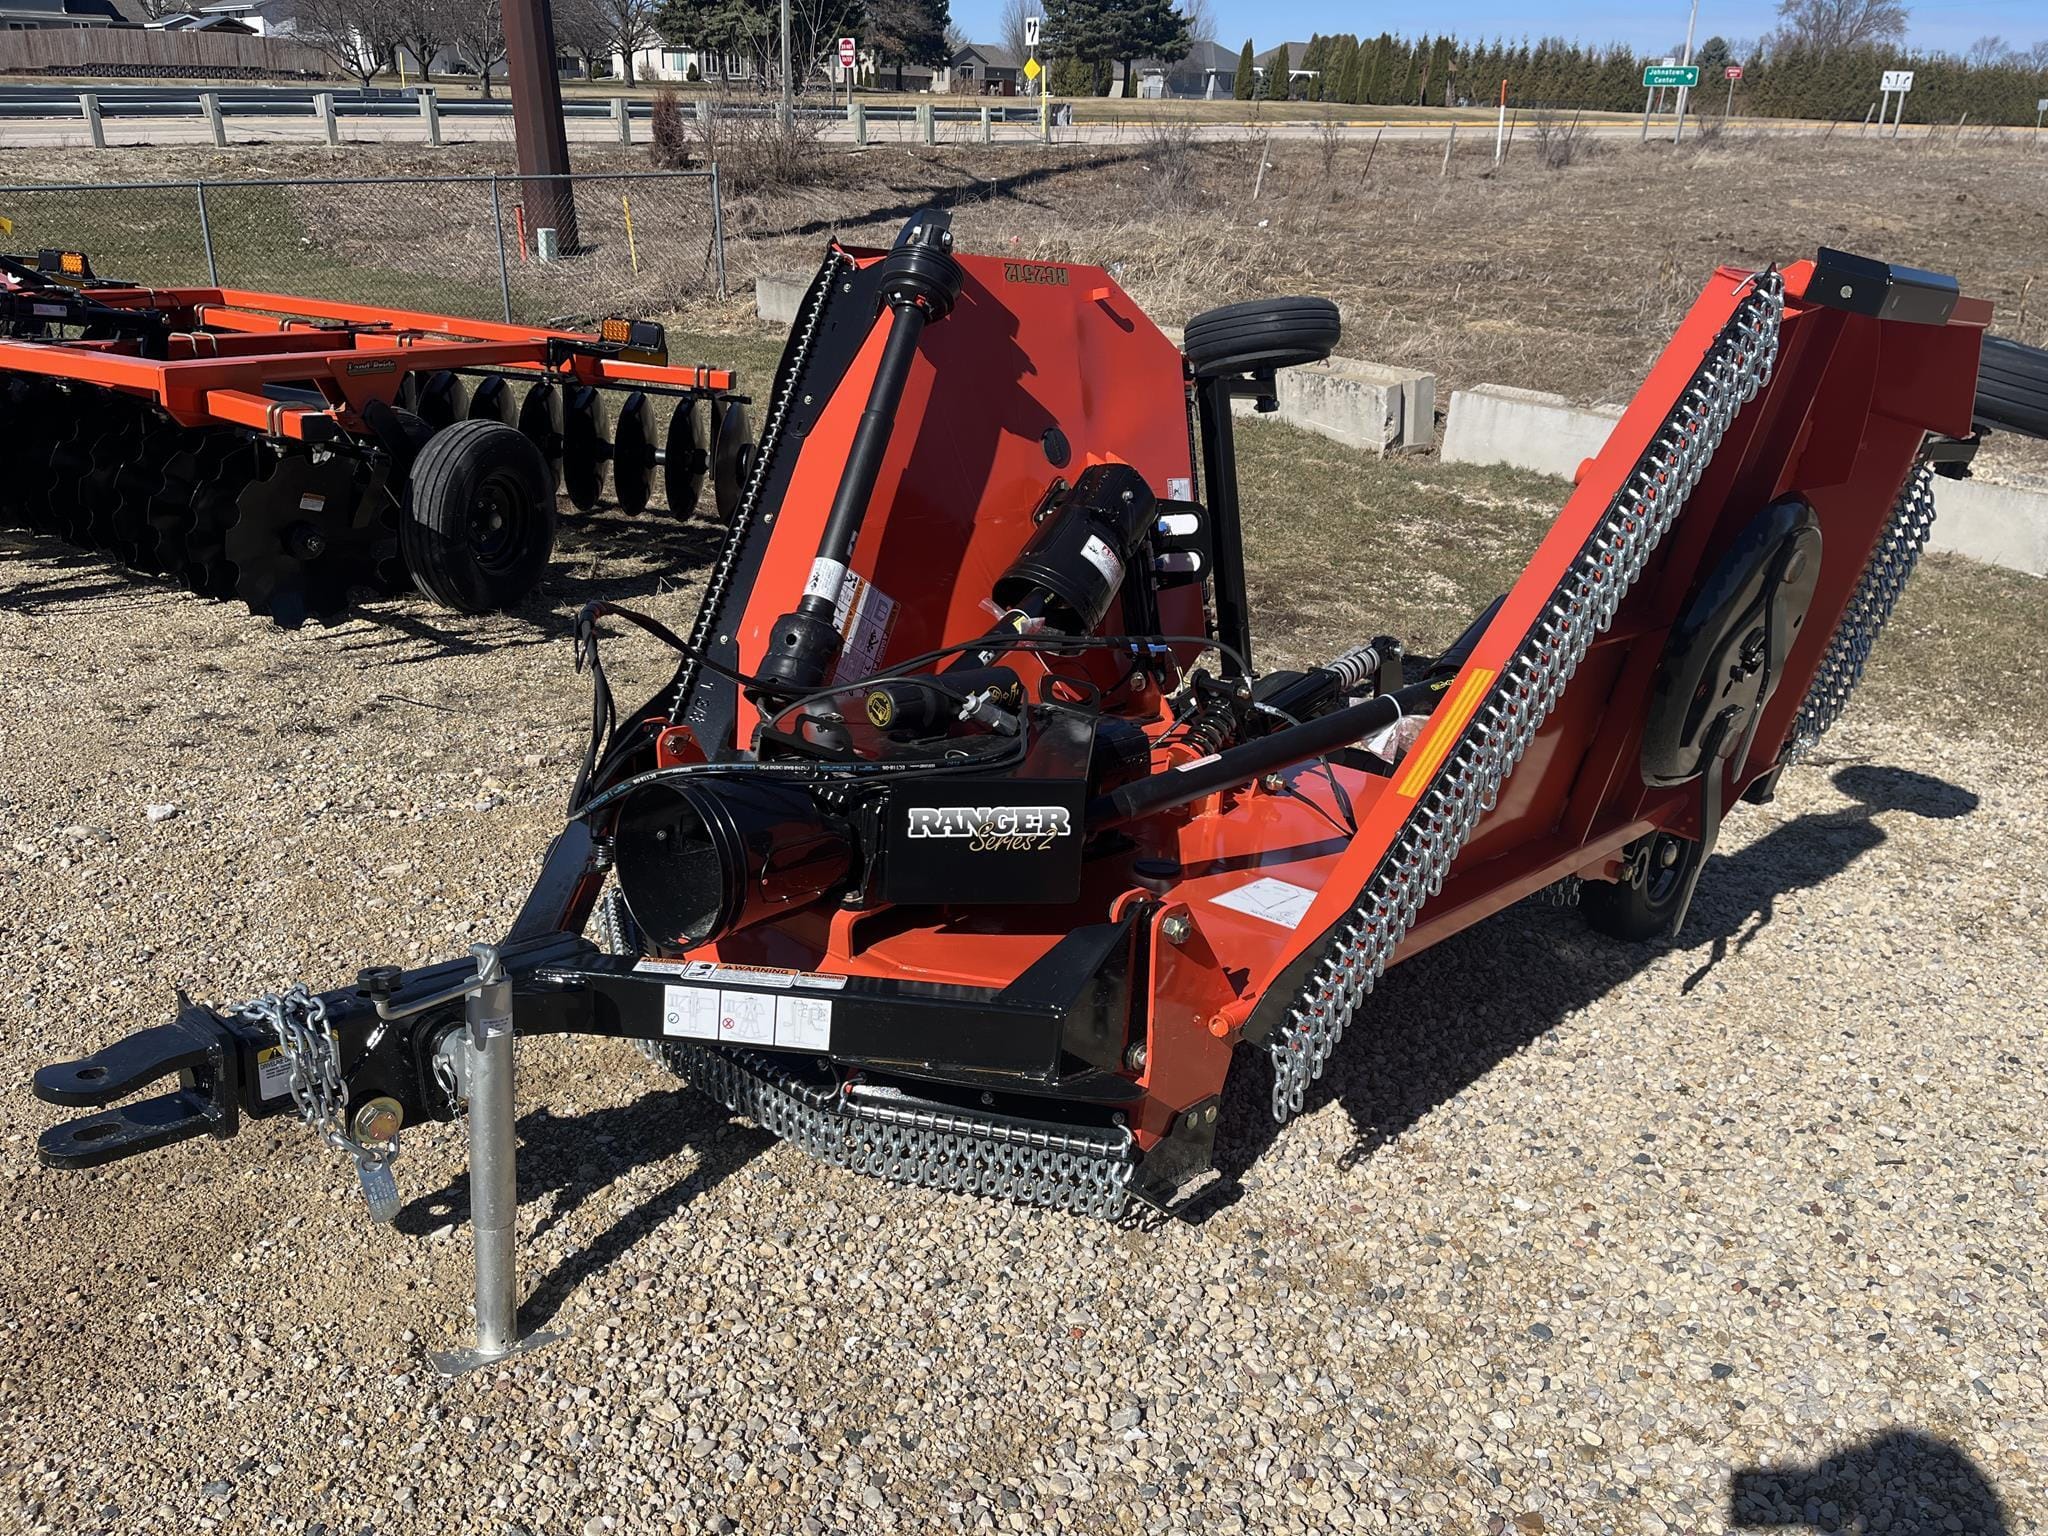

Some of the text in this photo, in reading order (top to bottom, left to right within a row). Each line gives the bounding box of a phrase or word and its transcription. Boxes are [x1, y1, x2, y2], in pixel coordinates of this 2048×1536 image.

[1004, 263, 1069, 286] RC2512
[908, 806, 1071, 838] RANGER
[969, 821, 1058, 851] Series 2
[734, 965, 789, 975] WARNING
